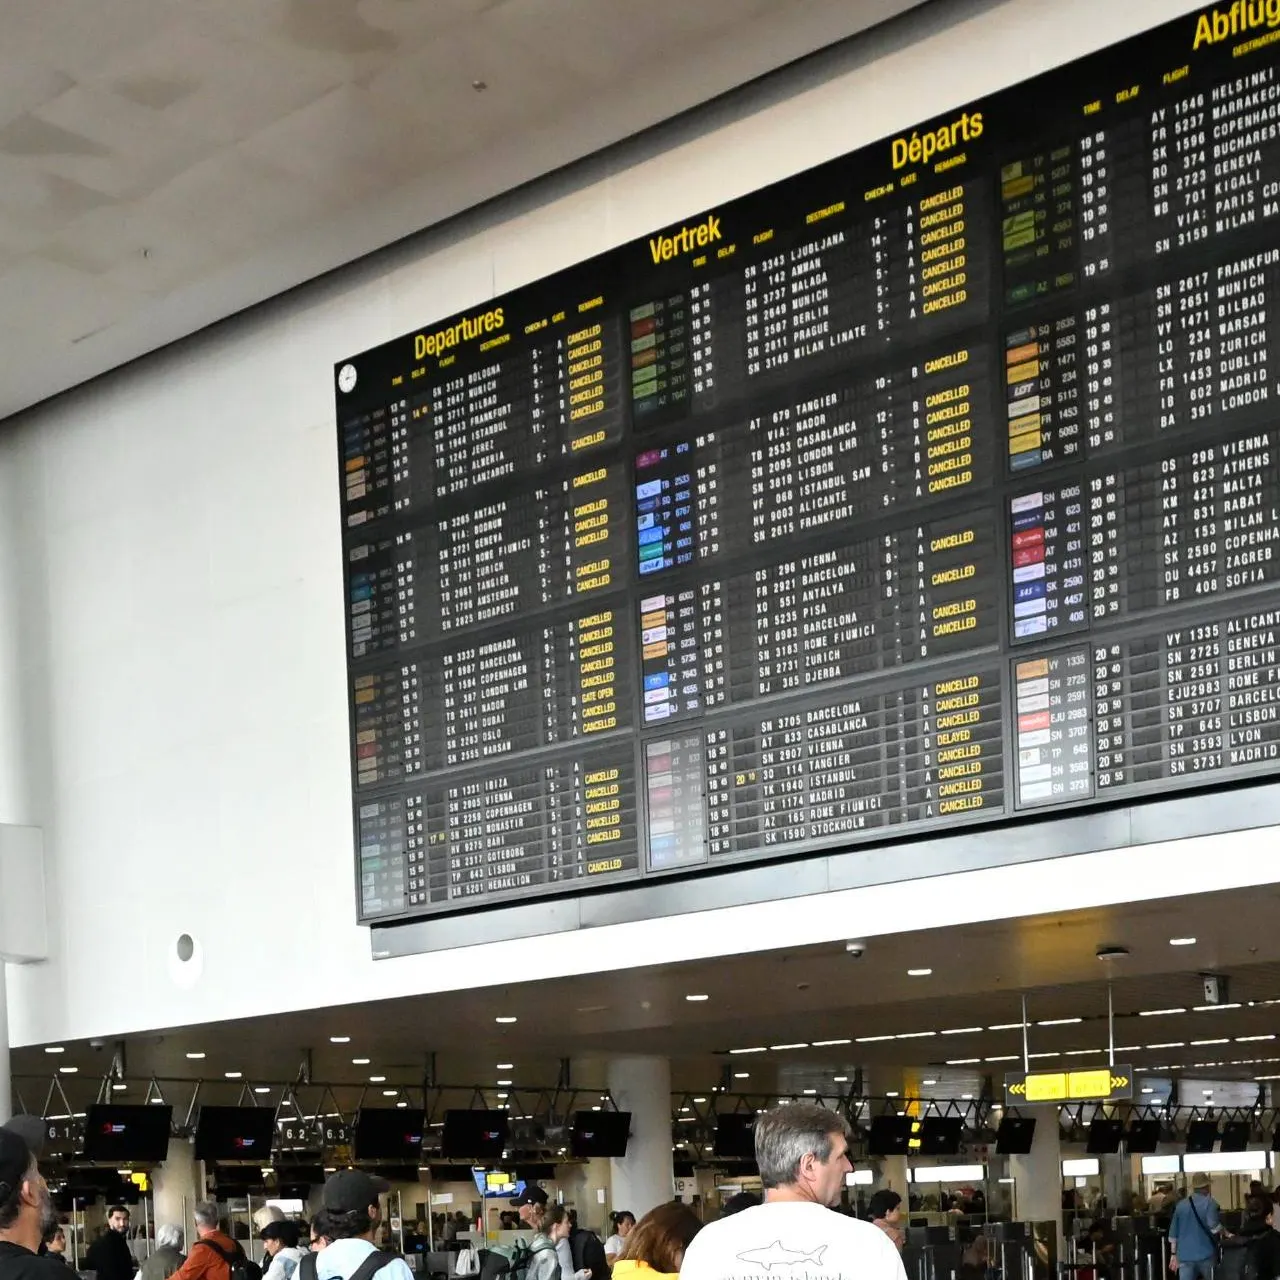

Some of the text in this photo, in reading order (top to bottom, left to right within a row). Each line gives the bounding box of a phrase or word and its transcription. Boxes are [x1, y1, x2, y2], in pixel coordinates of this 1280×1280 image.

[1163, 66, 1190, 84] FLIGHT
[1116, 85, 1140, 102] DELAY
[1152, 67, 1272, 123] AY 1546 HELSINKI
[1084, 100, 1101, 116] TIME
[1152, 127, 1166, 142] FR
[1175, 113, 1203, 134] 5237
[892, 112, 984, 170] Départs
[1153, 146, 1166, 161] SK
[1176, 132, 1204, 152] 1596
[920, 186, 963, 211] CANCELLED
[650, 215, 722, 264] Vertrek
[1156, 238, 1169, 253] SN
[1179, 225, 1207, 245] 3159
[1216, 210, 1254, 232] MILAN
[1156, 284, 1170, 299] SN
[1180, 272, 1208, 292] 2617
[415, 308, 504, 360] Departures
[924, 350, 968, 373] CANCELLED
[1159, 358, 1172, 372] LX
[1189, 347, 1210, 363] 789
[1220, 330, 1265, 354] ZURICH
[1014, 382, 1034, 396] LOT
[926, 402, 969, 424] CANCELLED
[1161, 413, 1174, 427] BA
[1191, 403, 1211, 419] 391
[1222, 387, 1267, 410] LONDON
[928, 471, 971, 492] CANCELLED
[1163, 514, 1176, 527] AT
[1194, 505, 1213, 520] 831
[1224, 492, 1261, 512] RABAT
[1164, 532, 1176, 545] AZ
[1195, 523, 1215, 538] 153
[1224, 512, 1262, 531] MILAN
[930, 531, 973, 551] CANCELLED
[1165, 550, 1178, 564] SK
[1188, 542, 1216, 559] 2590
[576, 574, 610, 591] CANCELLED
[1167, 632, 1180, 645] VY
[1190, 624, 1218, 640] 1335
[1168, 650, 1274, 682] SN 2591 BERLIN
[936, 676, 978, 694] CANCELLED
[1168, 680, 1219, 700] EJU2983
[1229, 672, 1258, 688] ROME
[938, 744, 980, 762] CANCELLED
[1171, 744, 1276, 773] SN 3731 MADRID
[585, 769, 618, 784] CANCELLED
[585, 784, 618, 798] CANCELLED
[49, 1127, 69, 1138] 6.1
[286, 1129, 304, 1139] 6.2
[327, 1129, 344, 1139] 6.3
